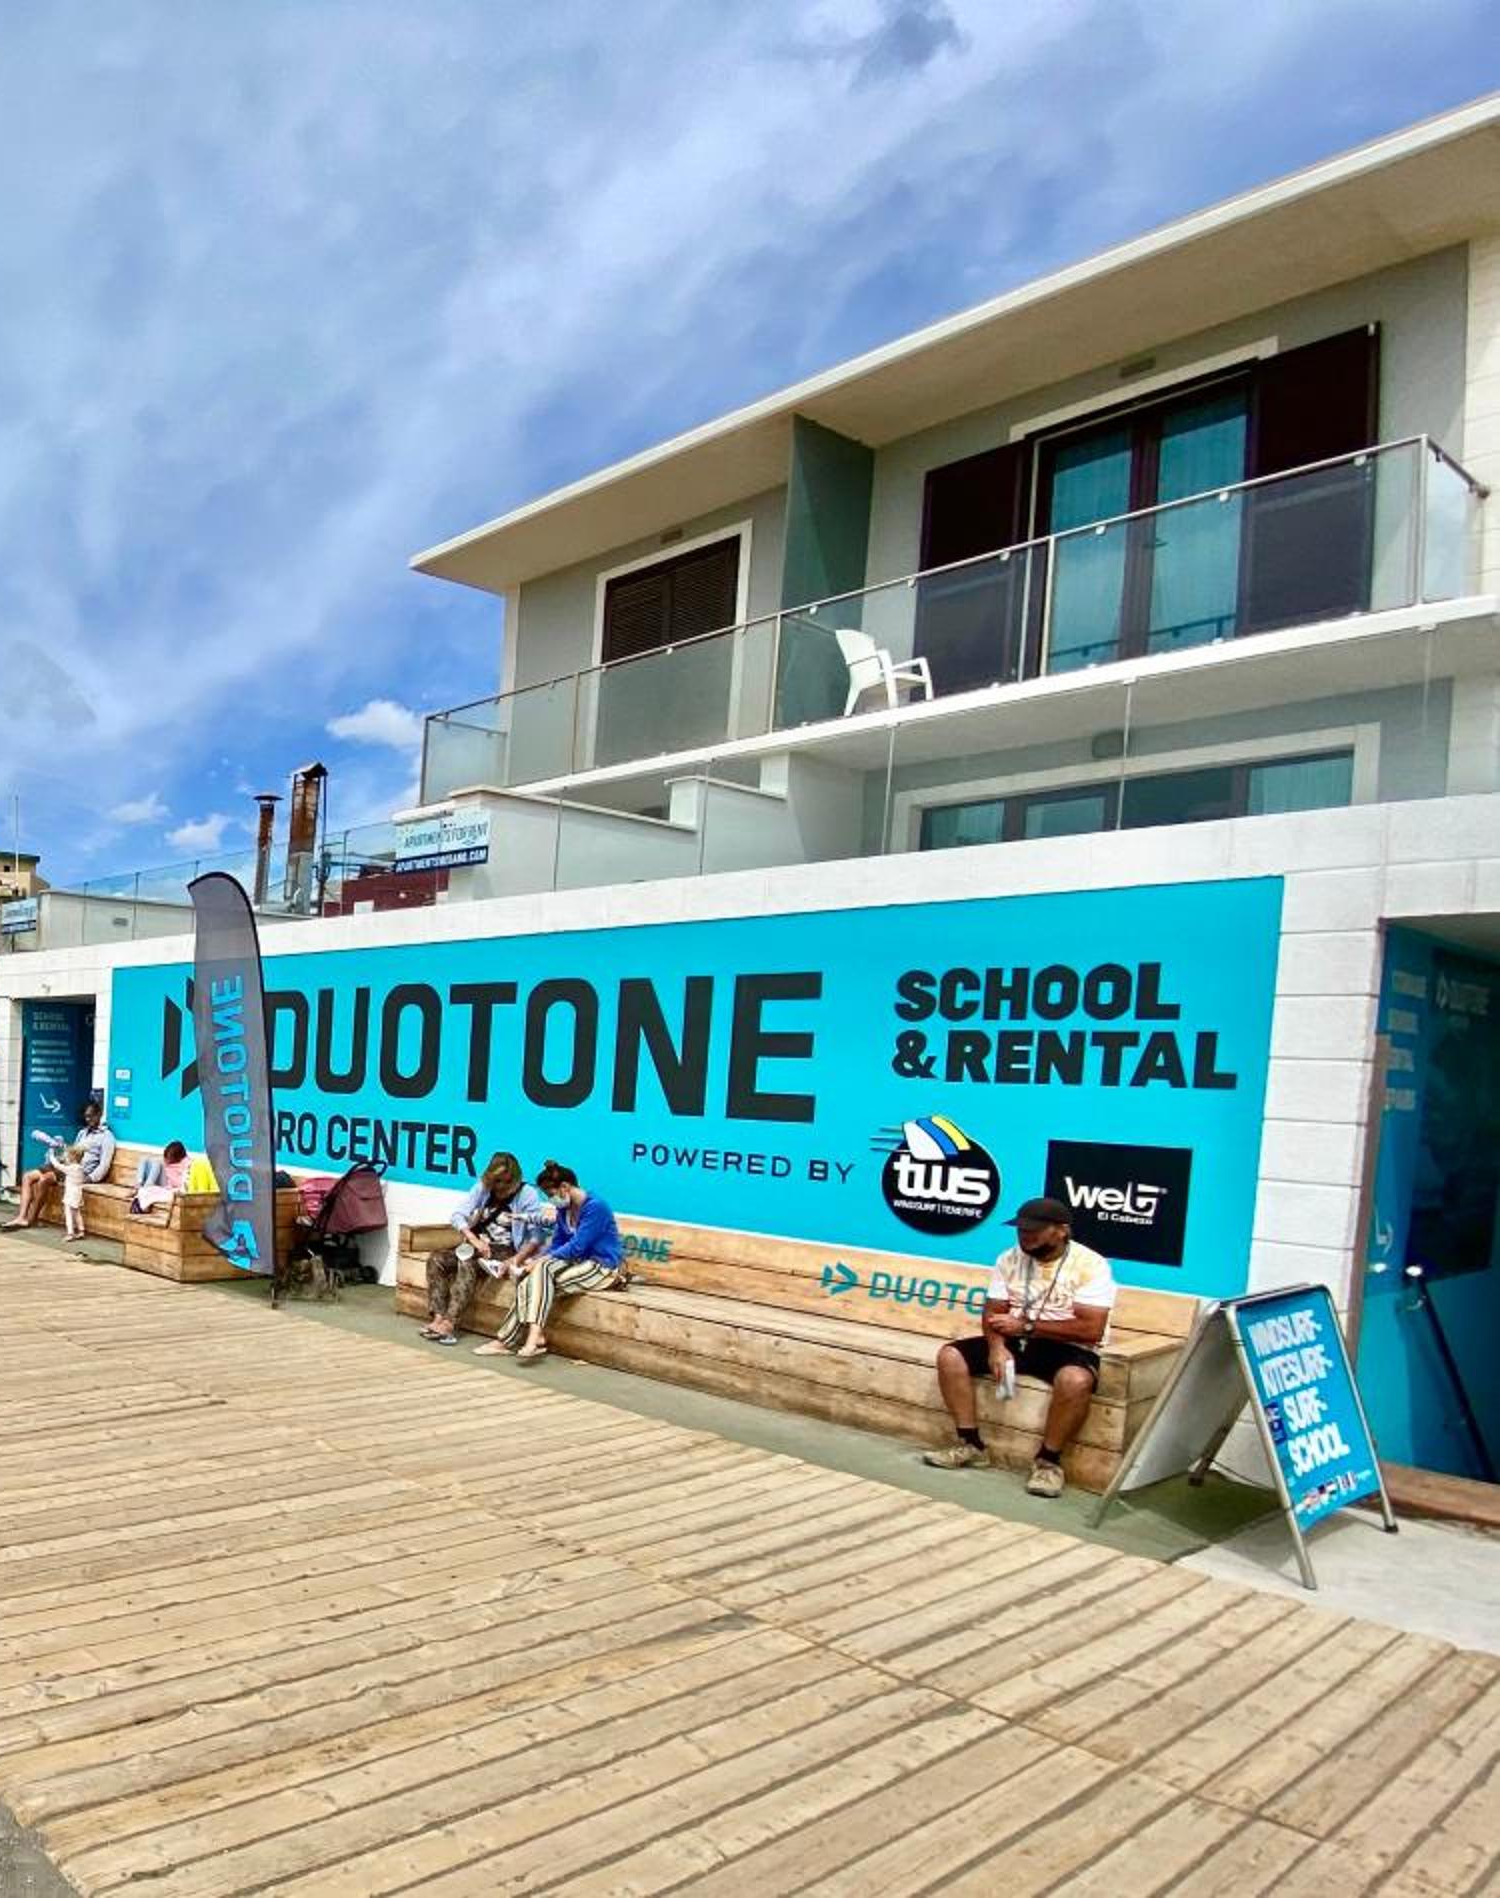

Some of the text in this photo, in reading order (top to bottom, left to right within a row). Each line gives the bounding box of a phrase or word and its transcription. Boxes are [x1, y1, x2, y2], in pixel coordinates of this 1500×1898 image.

[894, 962, 1181, 1022] SCHOOL
[263, 971, 823, 1124] DUOTONE
[275, 1109, 478, 1177] RO CENTER
[632, 1143, 855, 1185] POWERED BY
[868, 1271, 988, 1316] DUOTO
[1287, 1421, 1350, 1478] SCHOOL
